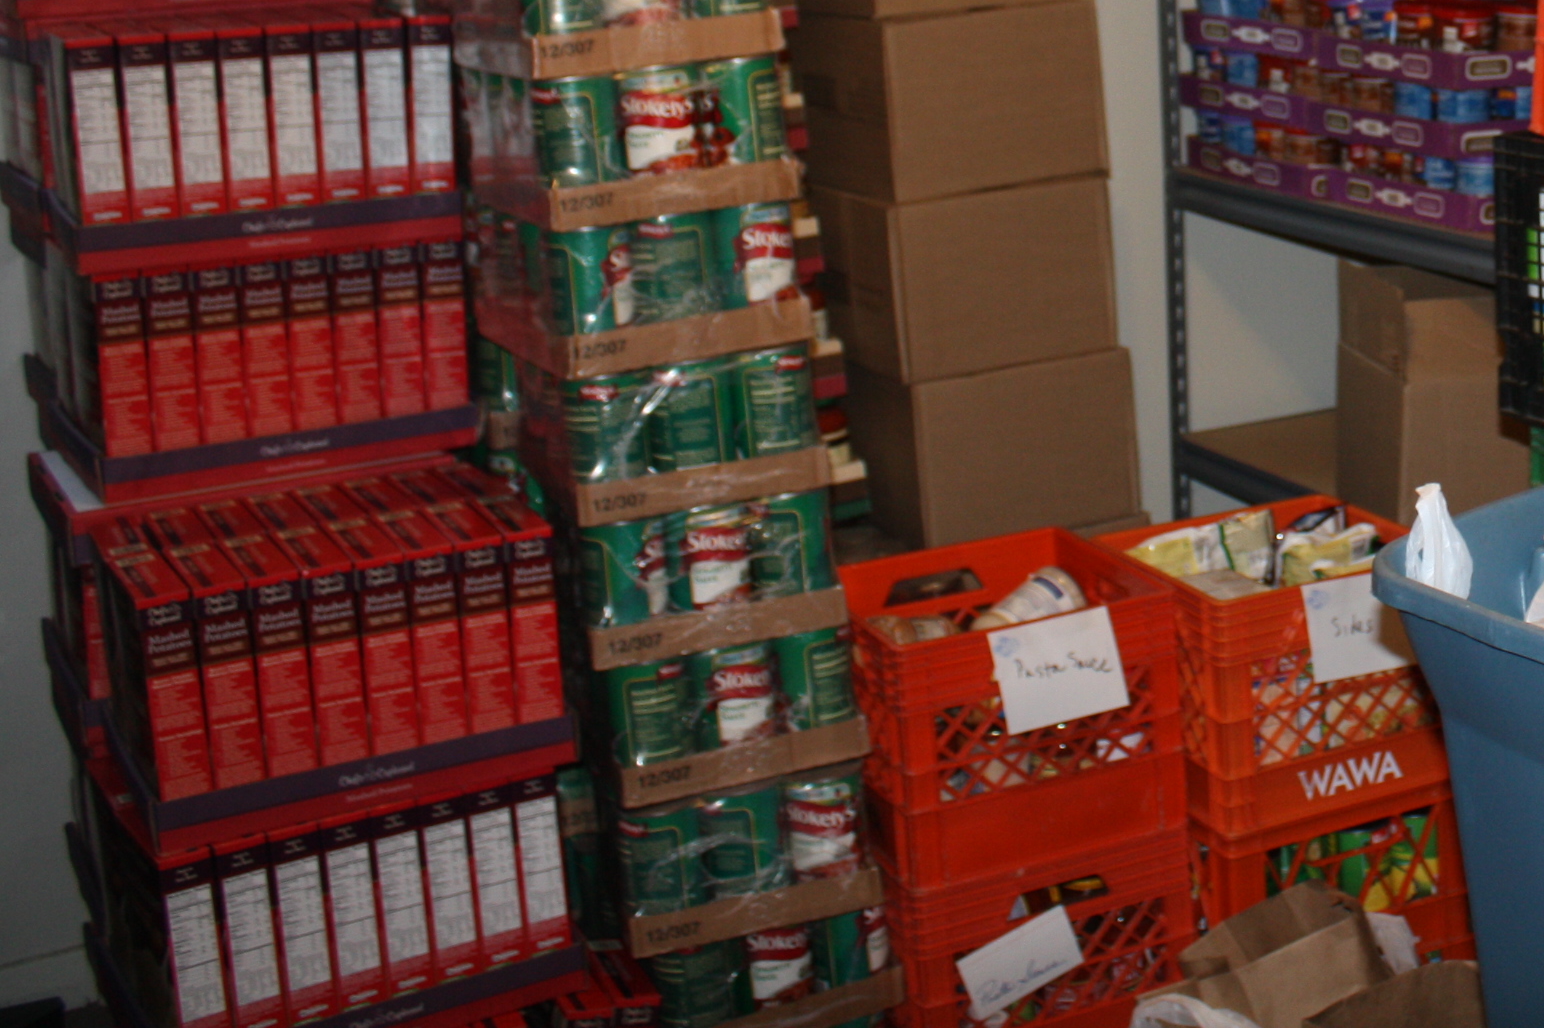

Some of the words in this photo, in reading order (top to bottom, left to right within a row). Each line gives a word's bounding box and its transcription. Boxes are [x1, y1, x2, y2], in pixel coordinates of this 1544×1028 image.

[540, 39, 595, 58] 12/307
[560, 191, 614, 214] 12/307
[572, 339, 627, 361] 12/307
[593, 492, 647, 512] 12/307
[609, 632, 662, 654] 12/307
[638, 766, 691, 788] 12/307
[1296, 750, 1404, 801] WAWA
[646, 923, 700, 943] 12/307
